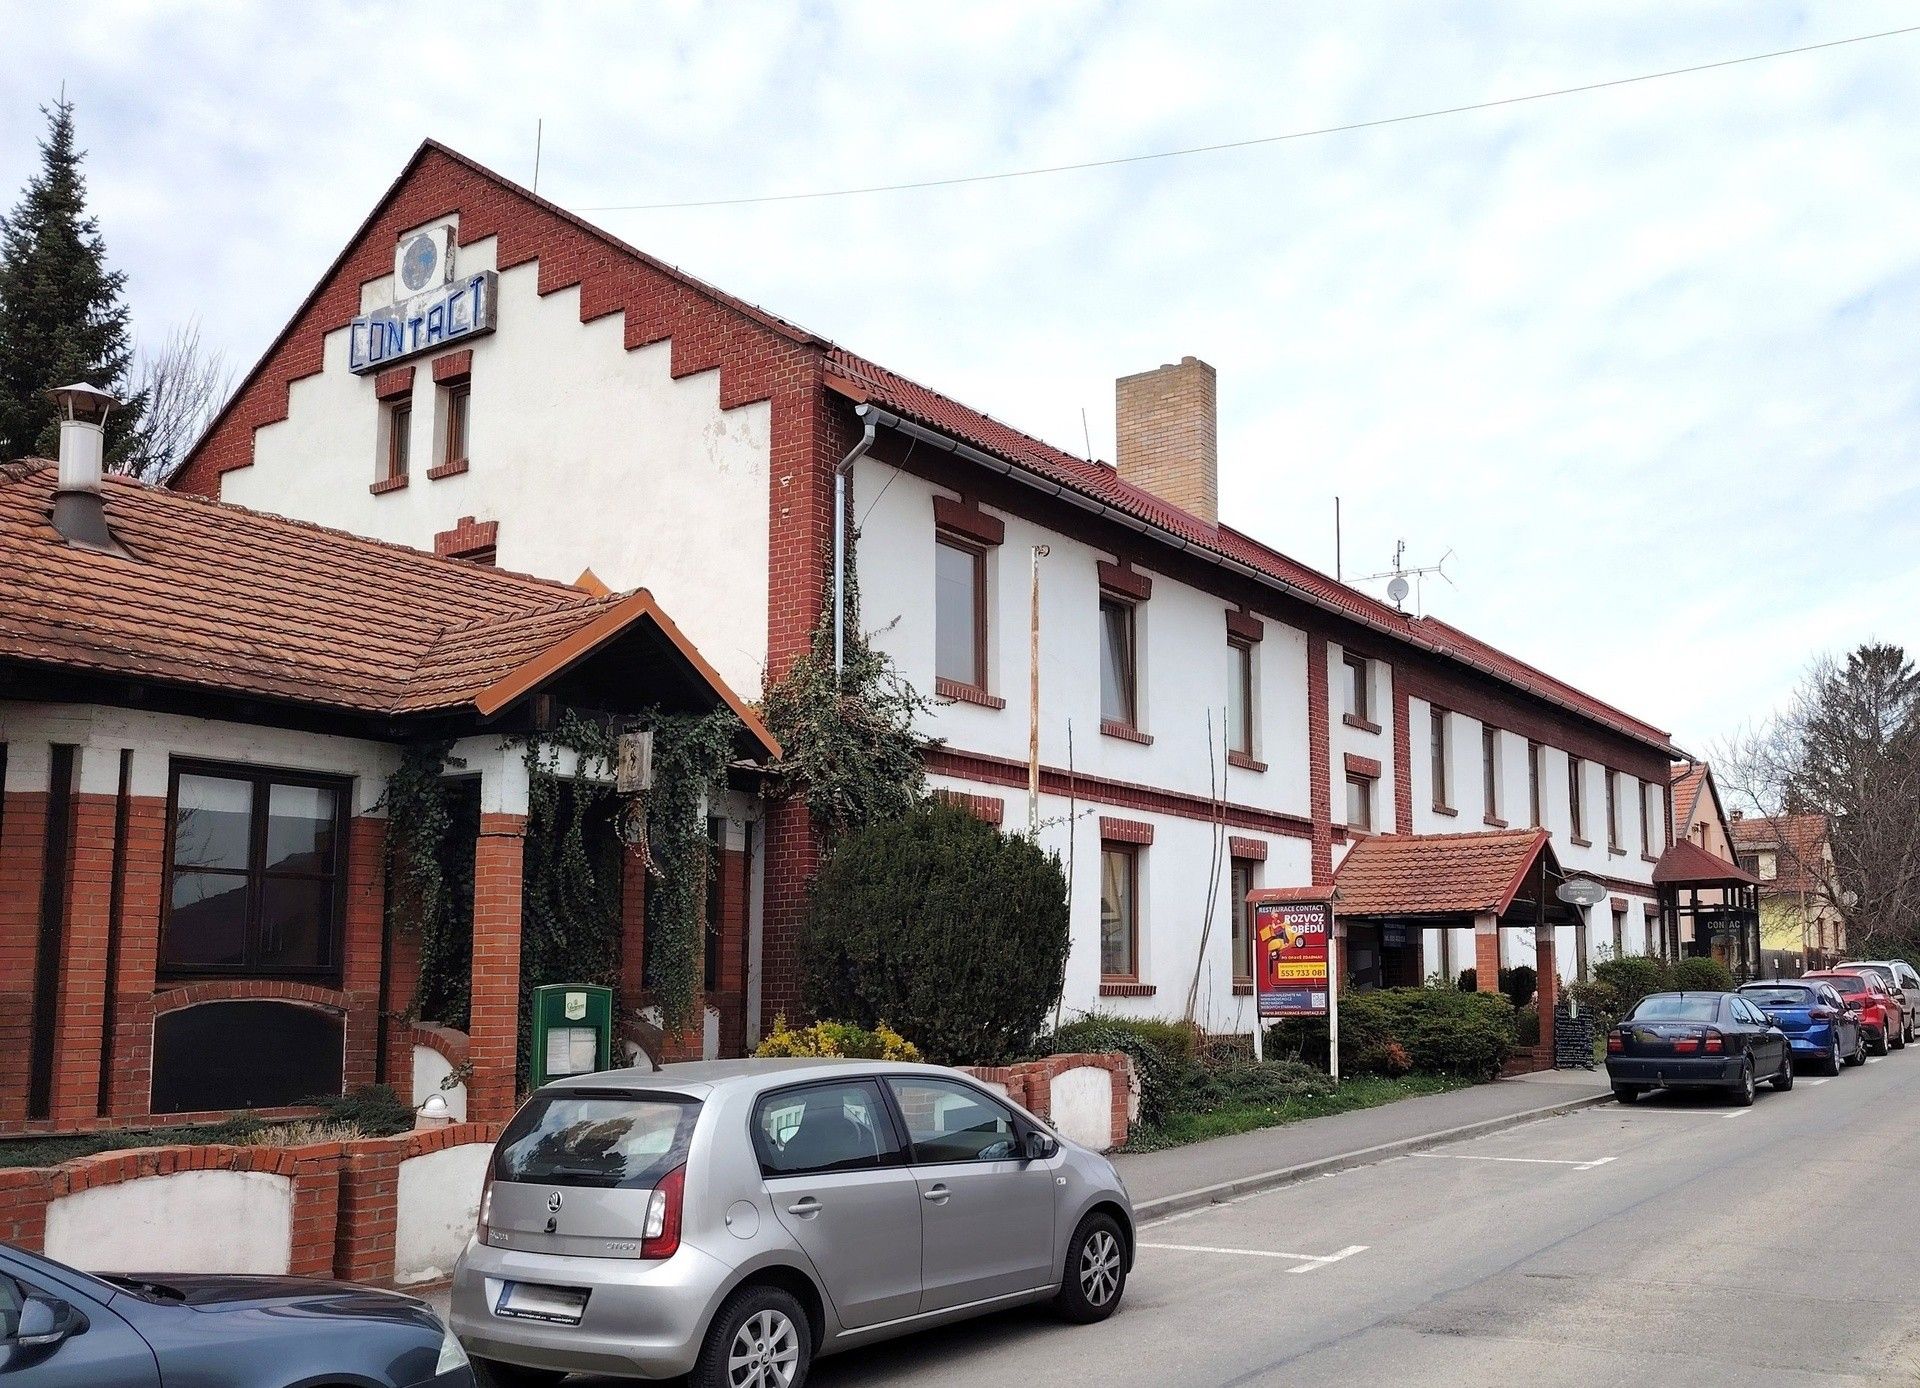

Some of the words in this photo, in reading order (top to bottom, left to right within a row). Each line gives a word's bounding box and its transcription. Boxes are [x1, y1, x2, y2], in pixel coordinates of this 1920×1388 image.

[350, 275, 485, 369] CONTACT
[1284, 913, 1325, 923] ROZVOZ
[1291, 921, 1324, 934] OBĚDŮ
[1280, 969, 1295, 977] 553
[1296, 969, 1310, 977] 733
[1311, 969, 1326, 977] 081
[606, 1241, 636, 1250] CITIGO
